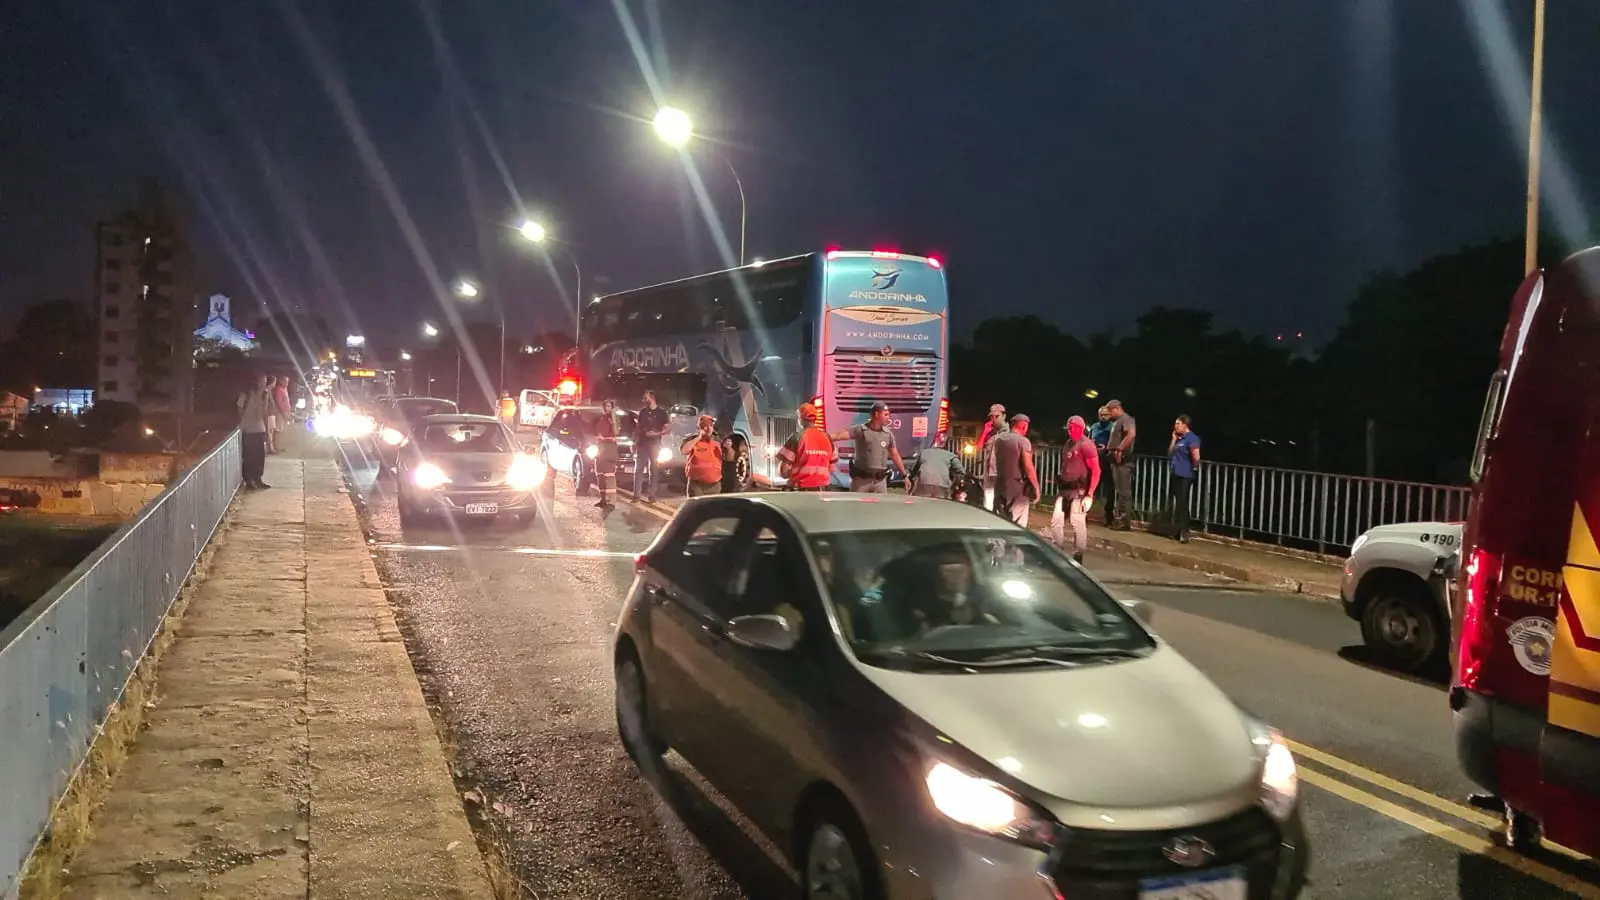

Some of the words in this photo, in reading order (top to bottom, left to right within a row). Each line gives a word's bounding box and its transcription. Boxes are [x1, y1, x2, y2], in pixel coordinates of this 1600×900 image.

[849, 290, 927, 303] ANDORINHA
[610, 344, 690, 368] ANDORINHA
[1433, 533, 1454, 546] 190
